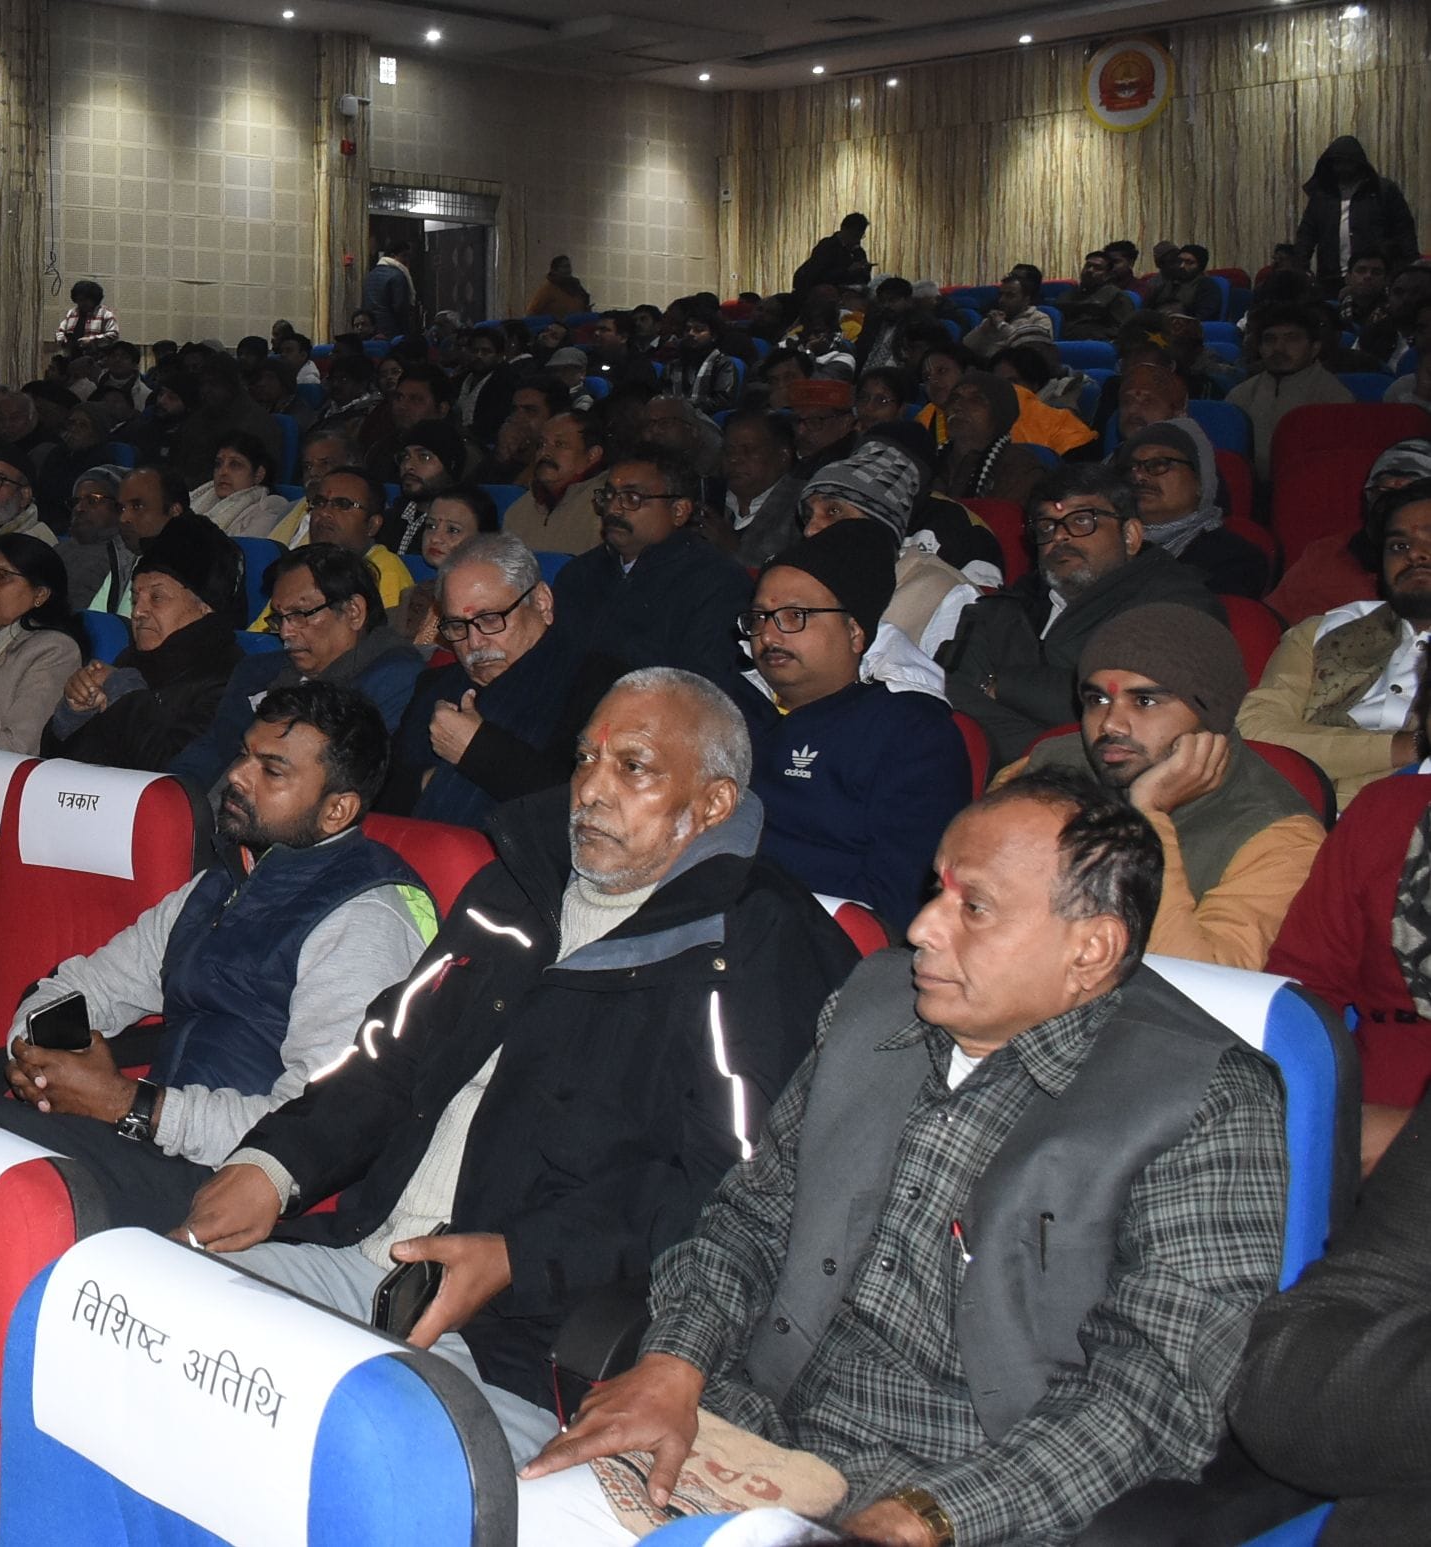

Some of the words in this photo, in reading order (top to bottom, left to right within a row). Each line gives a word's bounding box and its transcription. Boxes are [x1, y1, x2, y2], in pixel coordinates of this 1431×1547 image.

[784, 768, 812, 779] adidas
[57, 791, 100, 811] पत्रकार
[72, 1279, 171, 1364] विशिष्ट
[183, 1349, 288, 1429] अतिथि
